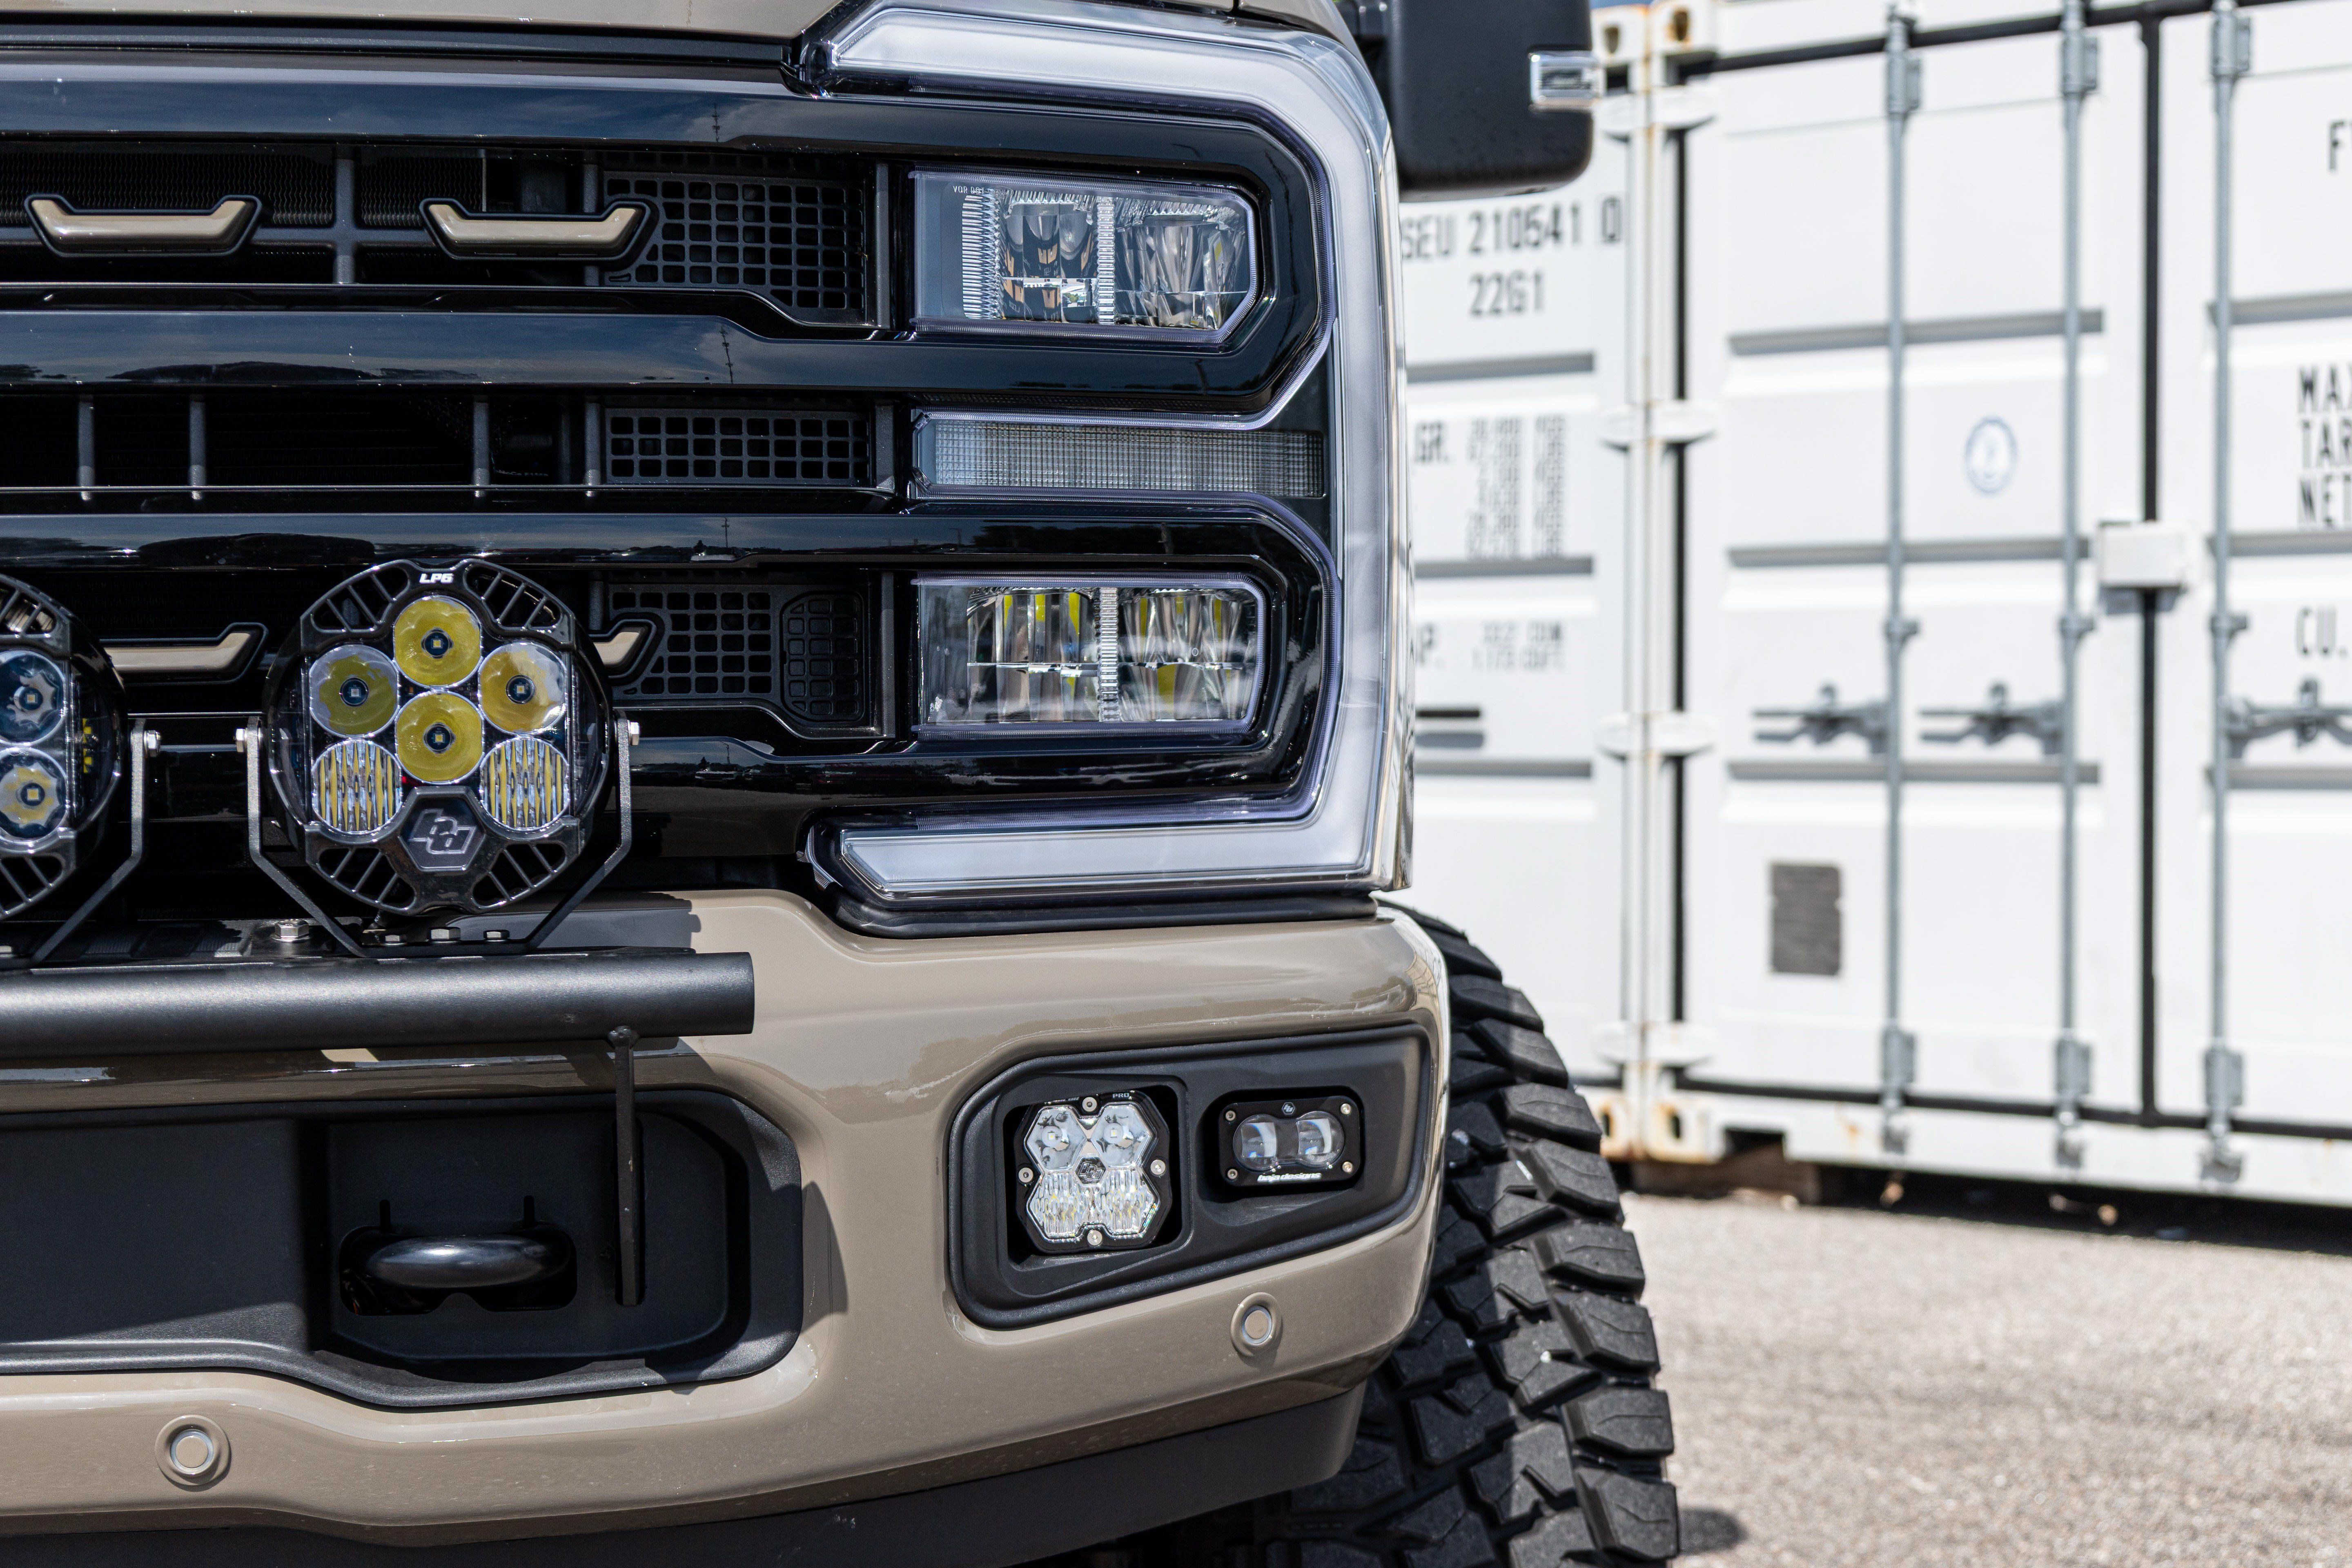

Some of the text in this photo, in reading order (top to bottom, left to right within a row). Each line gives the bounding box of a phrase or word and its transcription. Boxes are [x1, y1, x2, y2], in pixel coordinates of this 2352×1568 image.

[1469, 202, 1581, 252] 210541
[2297, 363, 2352, 413] MA
[419, 573, 454, 584] LP6
